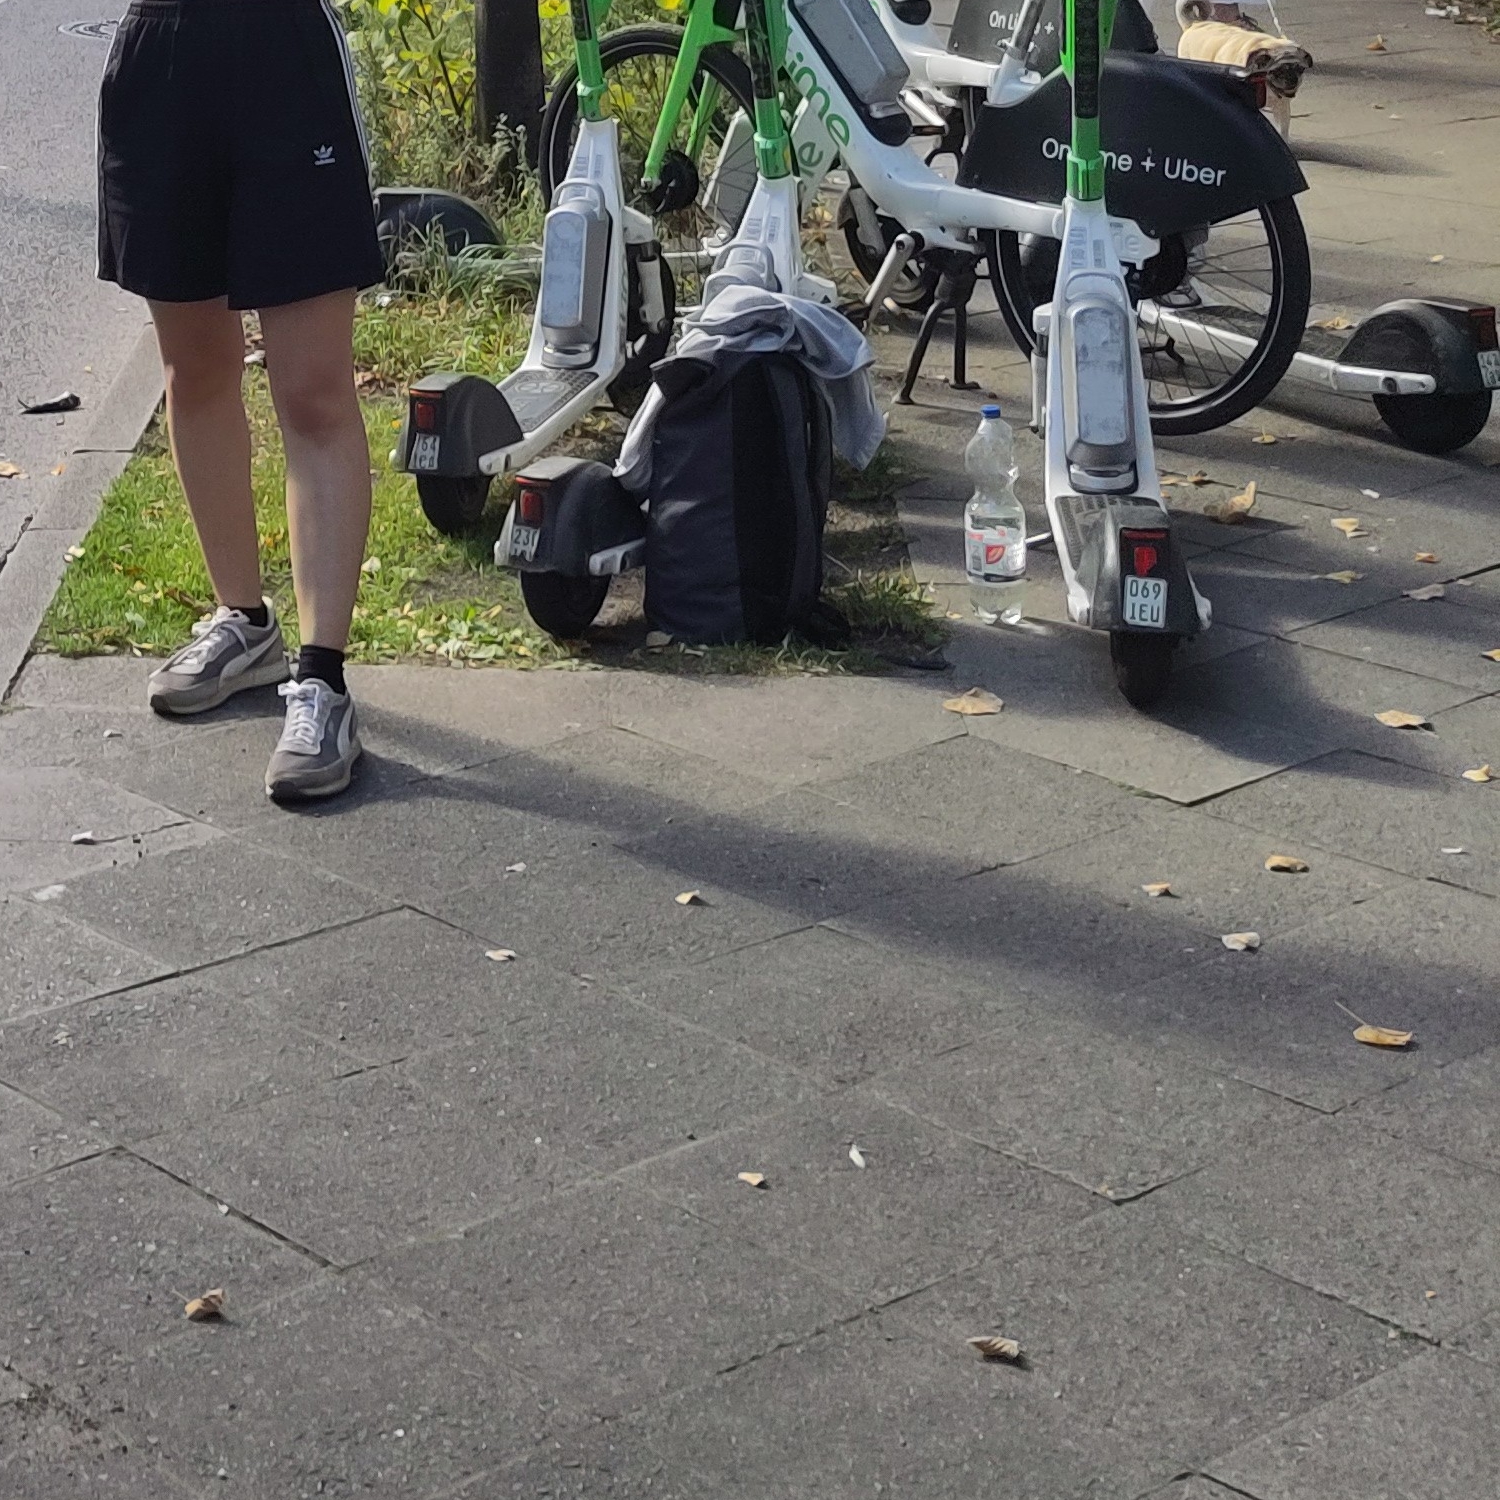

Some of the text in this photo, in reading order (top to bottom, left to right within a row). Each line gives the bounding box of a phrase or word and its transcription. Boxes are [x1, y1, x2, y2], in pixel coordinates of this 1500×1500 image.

[787, 27, 850, 148] ime
[1164, 156, 1227, 187] Uber
[1130, 579, 1162, 600] 069
[1129, 602, 1160, 623] IEU
